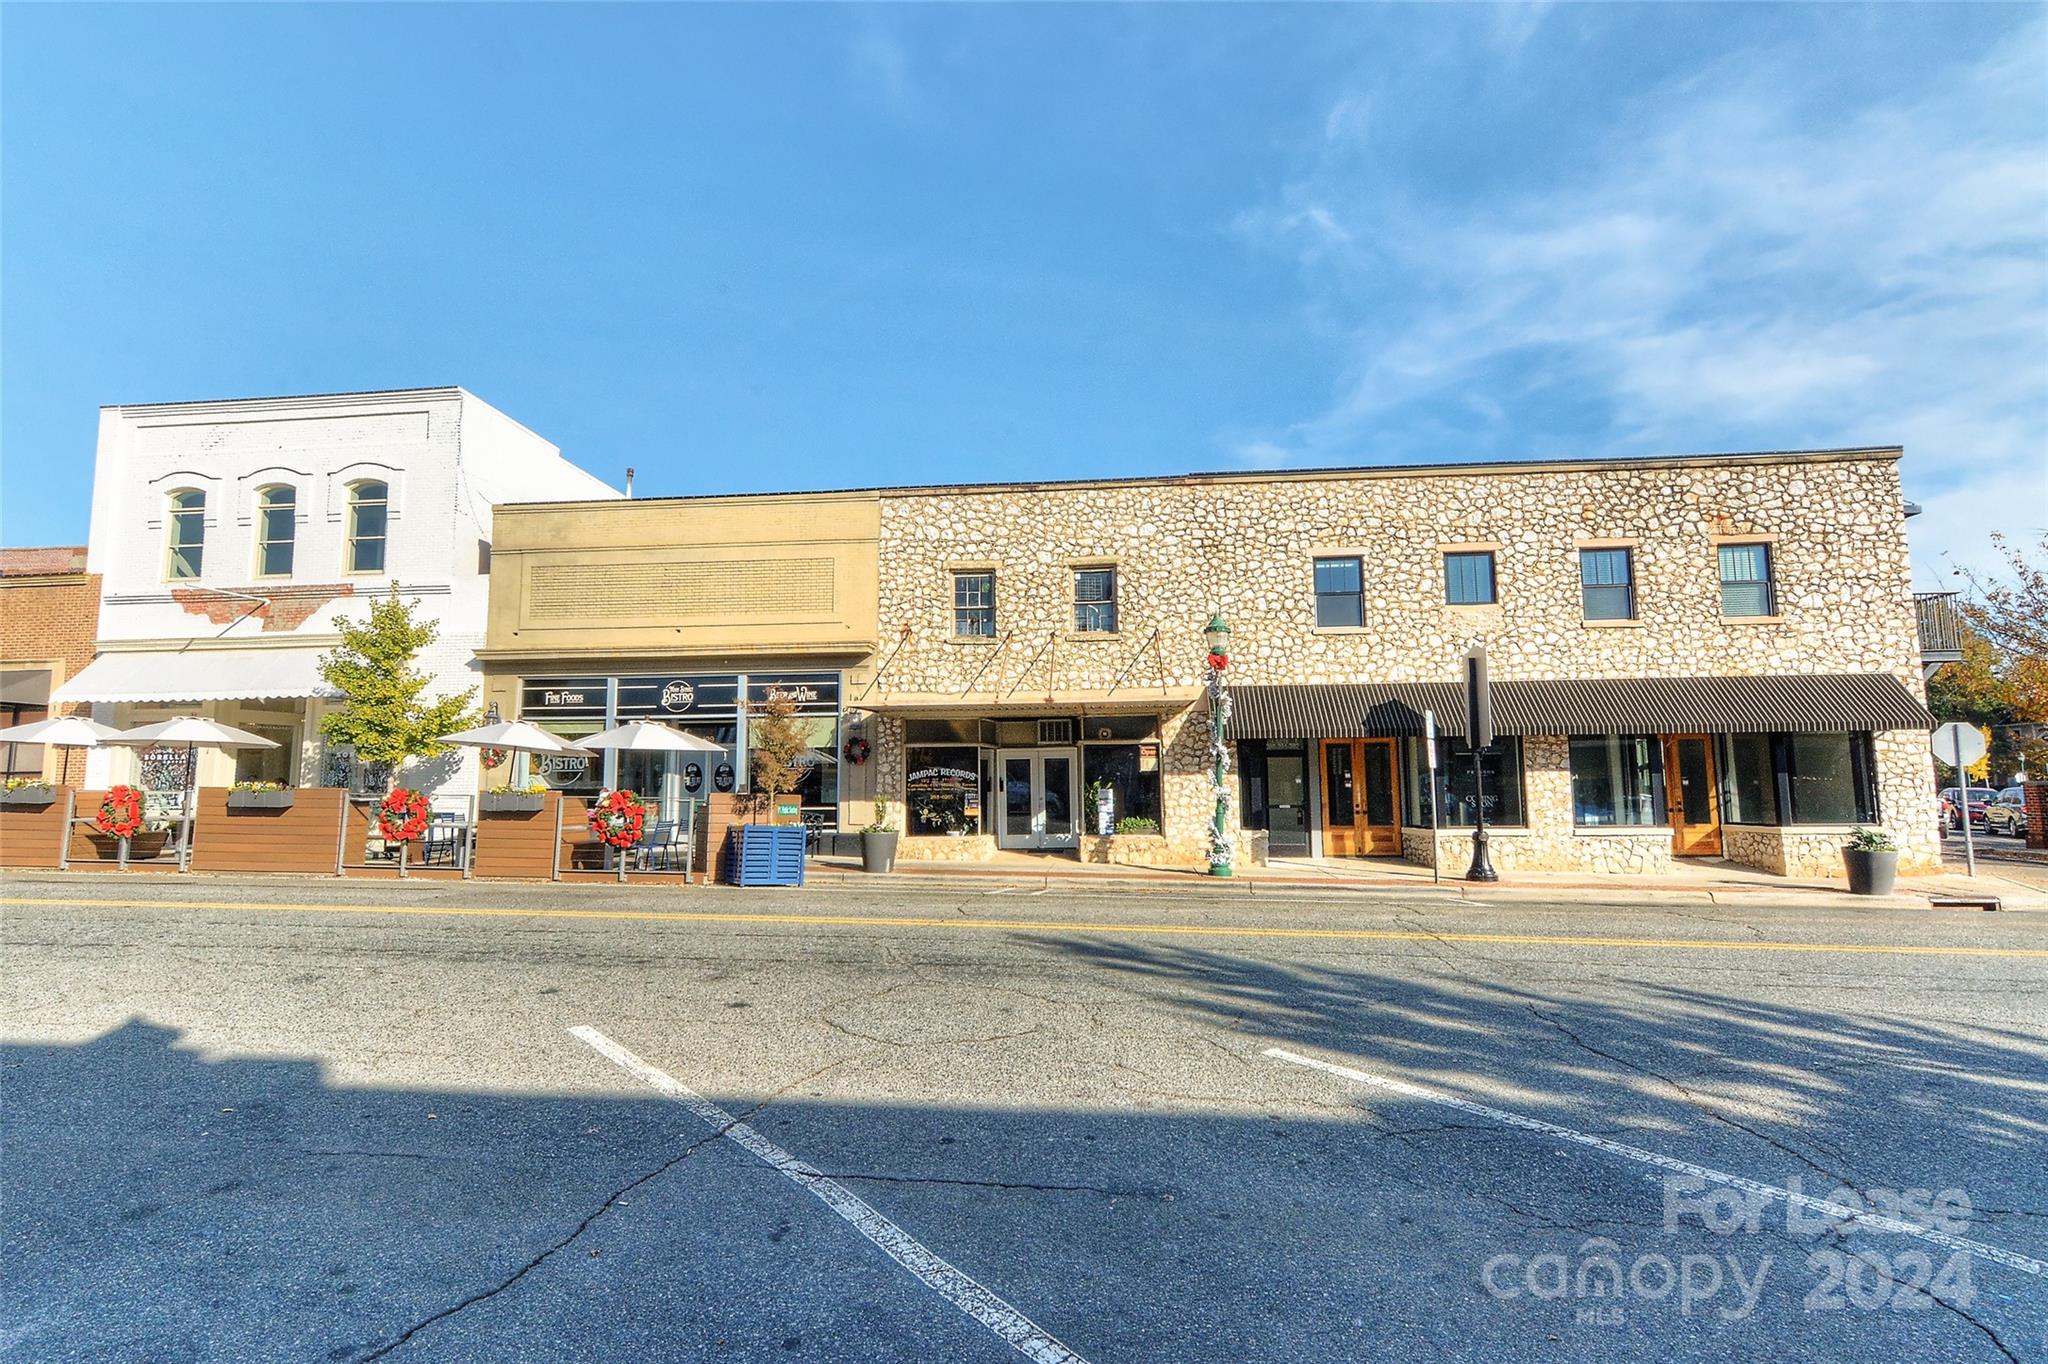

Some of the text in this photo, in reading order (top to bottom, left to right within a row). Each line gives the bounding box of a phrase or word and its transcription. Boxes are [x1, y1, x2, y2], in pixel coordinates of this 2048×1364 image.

[661, 688, 694, 706] BISTRO
[539, 752, 585, 776] BISTRO
[907, 768, 939, 782] JAMPAC
[940, 767, 977, 781] RECORDS
